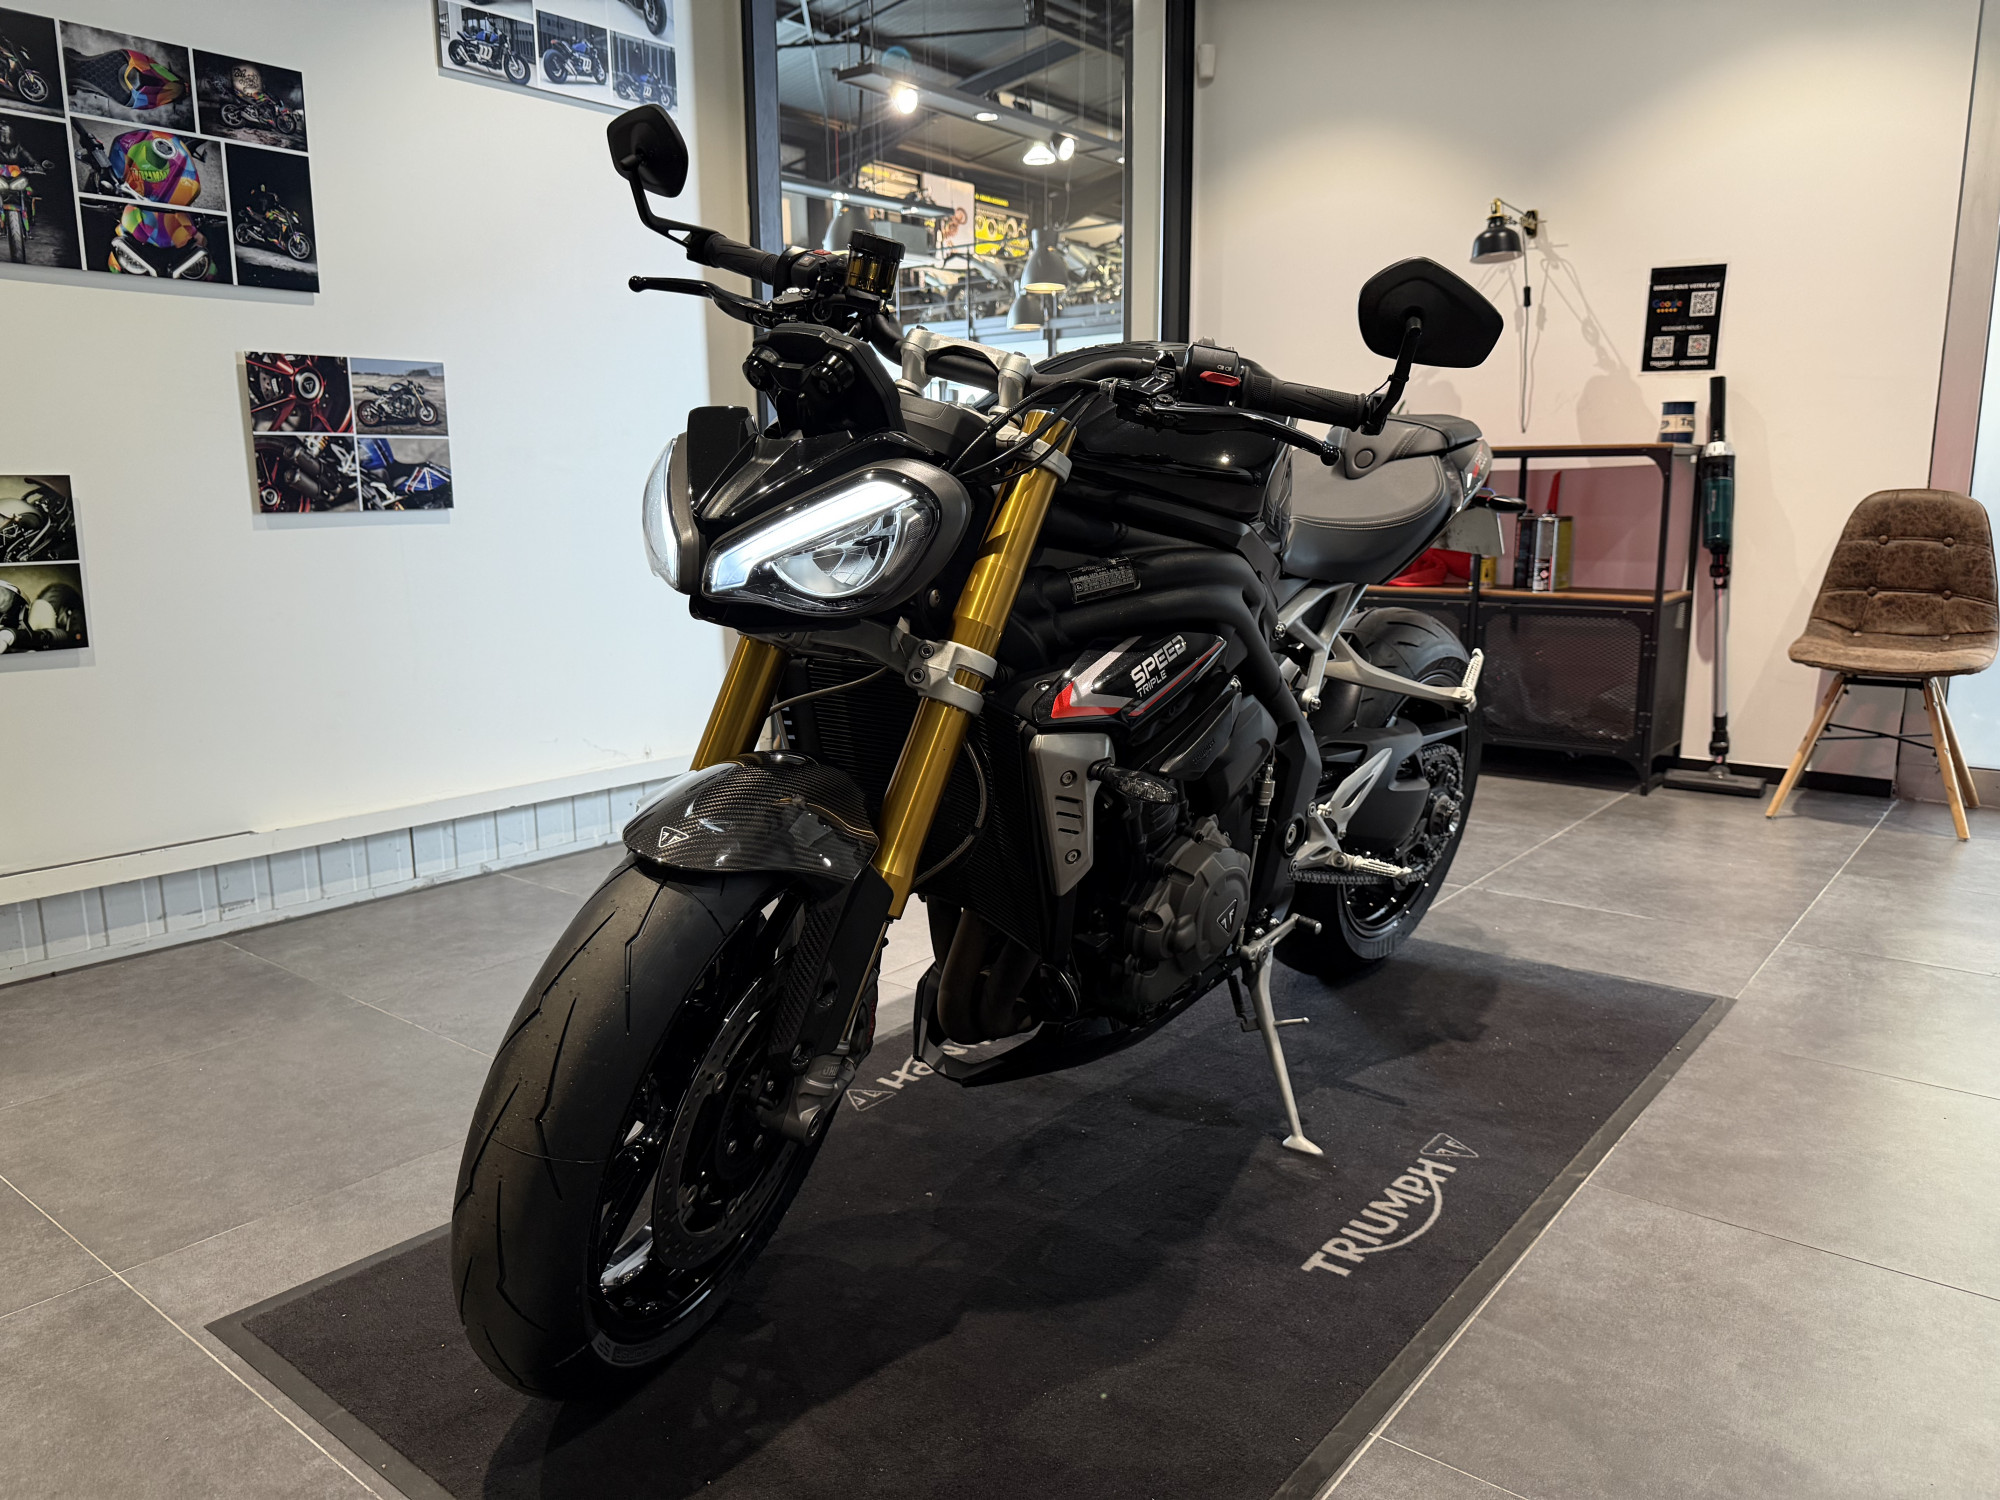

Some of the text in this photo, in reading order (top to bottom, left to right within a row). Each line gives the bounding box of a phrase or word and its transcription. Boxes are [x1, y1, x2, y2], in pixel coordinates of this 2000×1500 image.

[1652, 299, 1683, 309] Google
[1130, 634, 1187, 689] SPEED
[1136, 669, 1167, 698] TRIPLE
[1301, 1157, 1457, 1278] TRIUMPH
